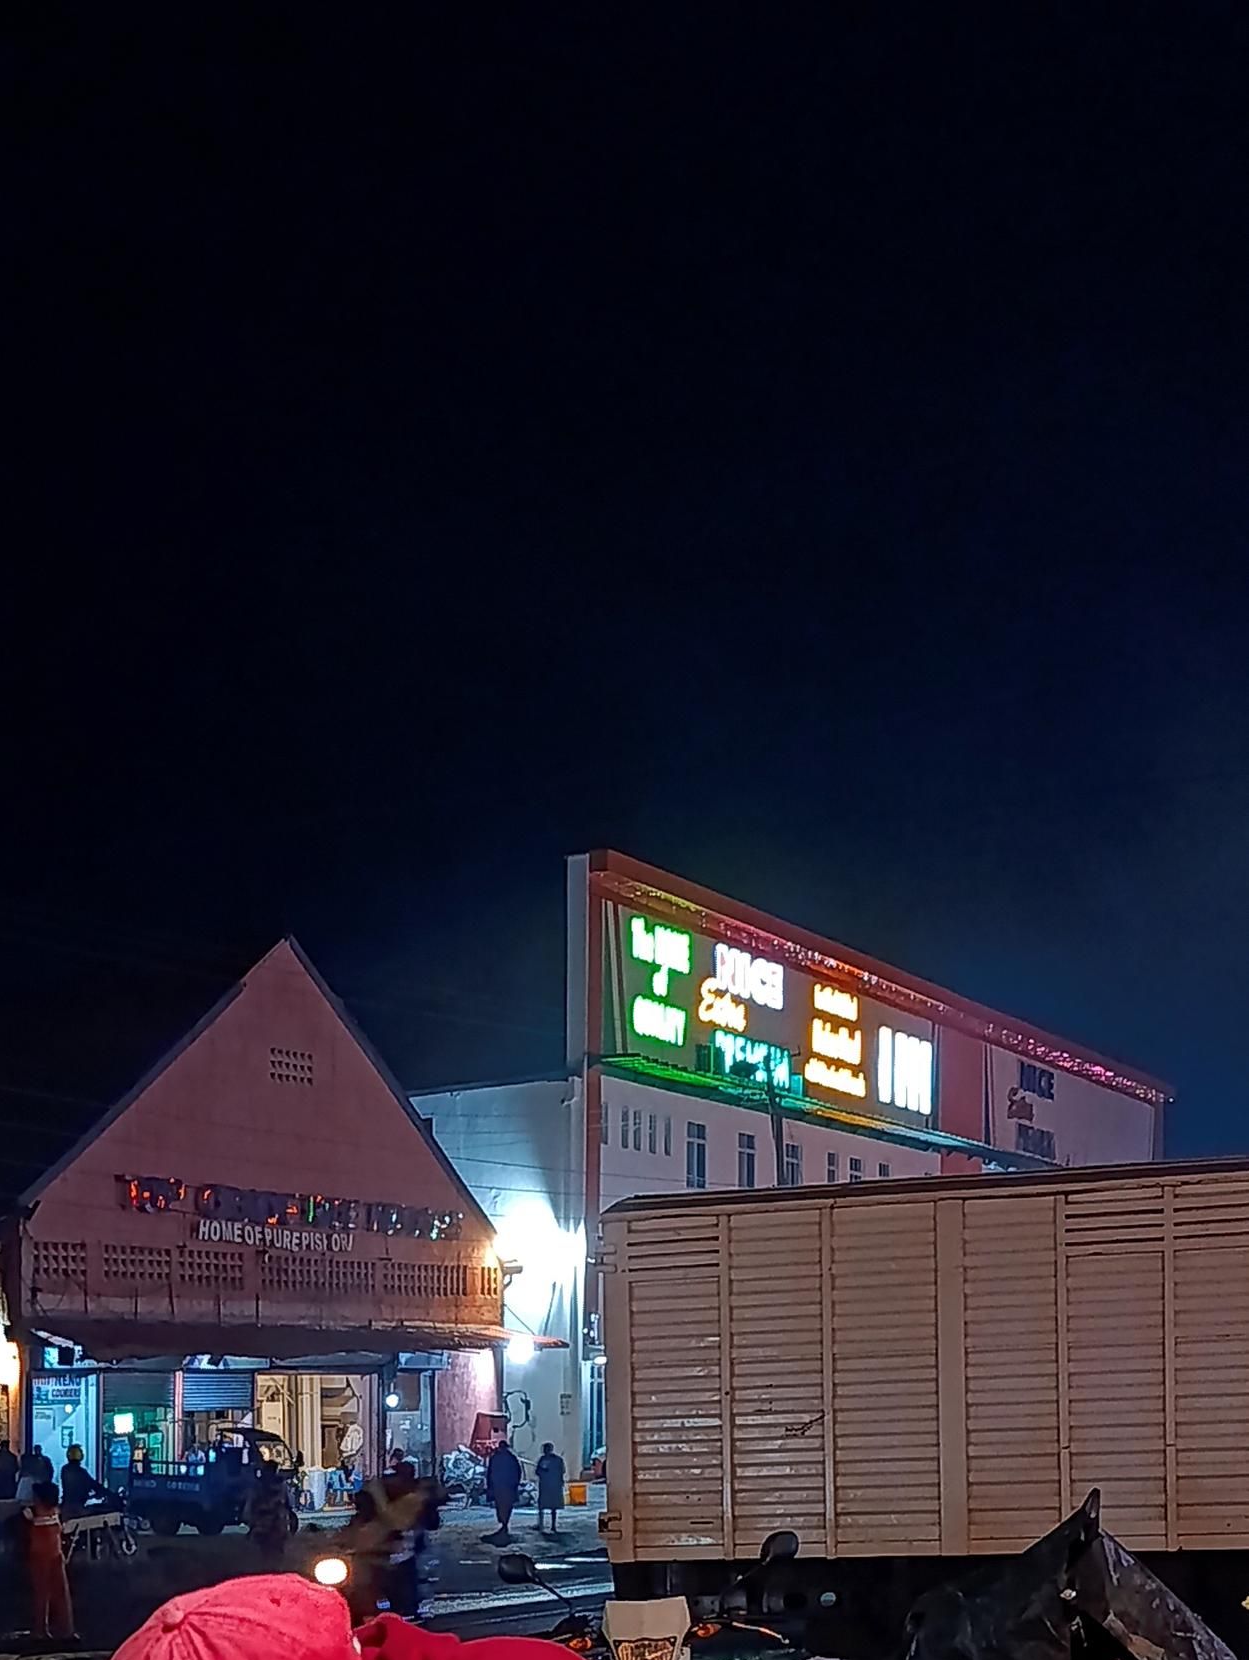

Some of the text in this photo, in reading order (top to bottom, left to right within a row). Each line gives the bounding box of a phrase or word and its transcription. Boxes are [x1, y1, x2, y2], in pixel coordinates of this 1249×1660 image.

[198, 1218, 243, 1243] HOME
[244, 1224, 264, 1246] OF
[264, 1228, 301, 1252] PURE
